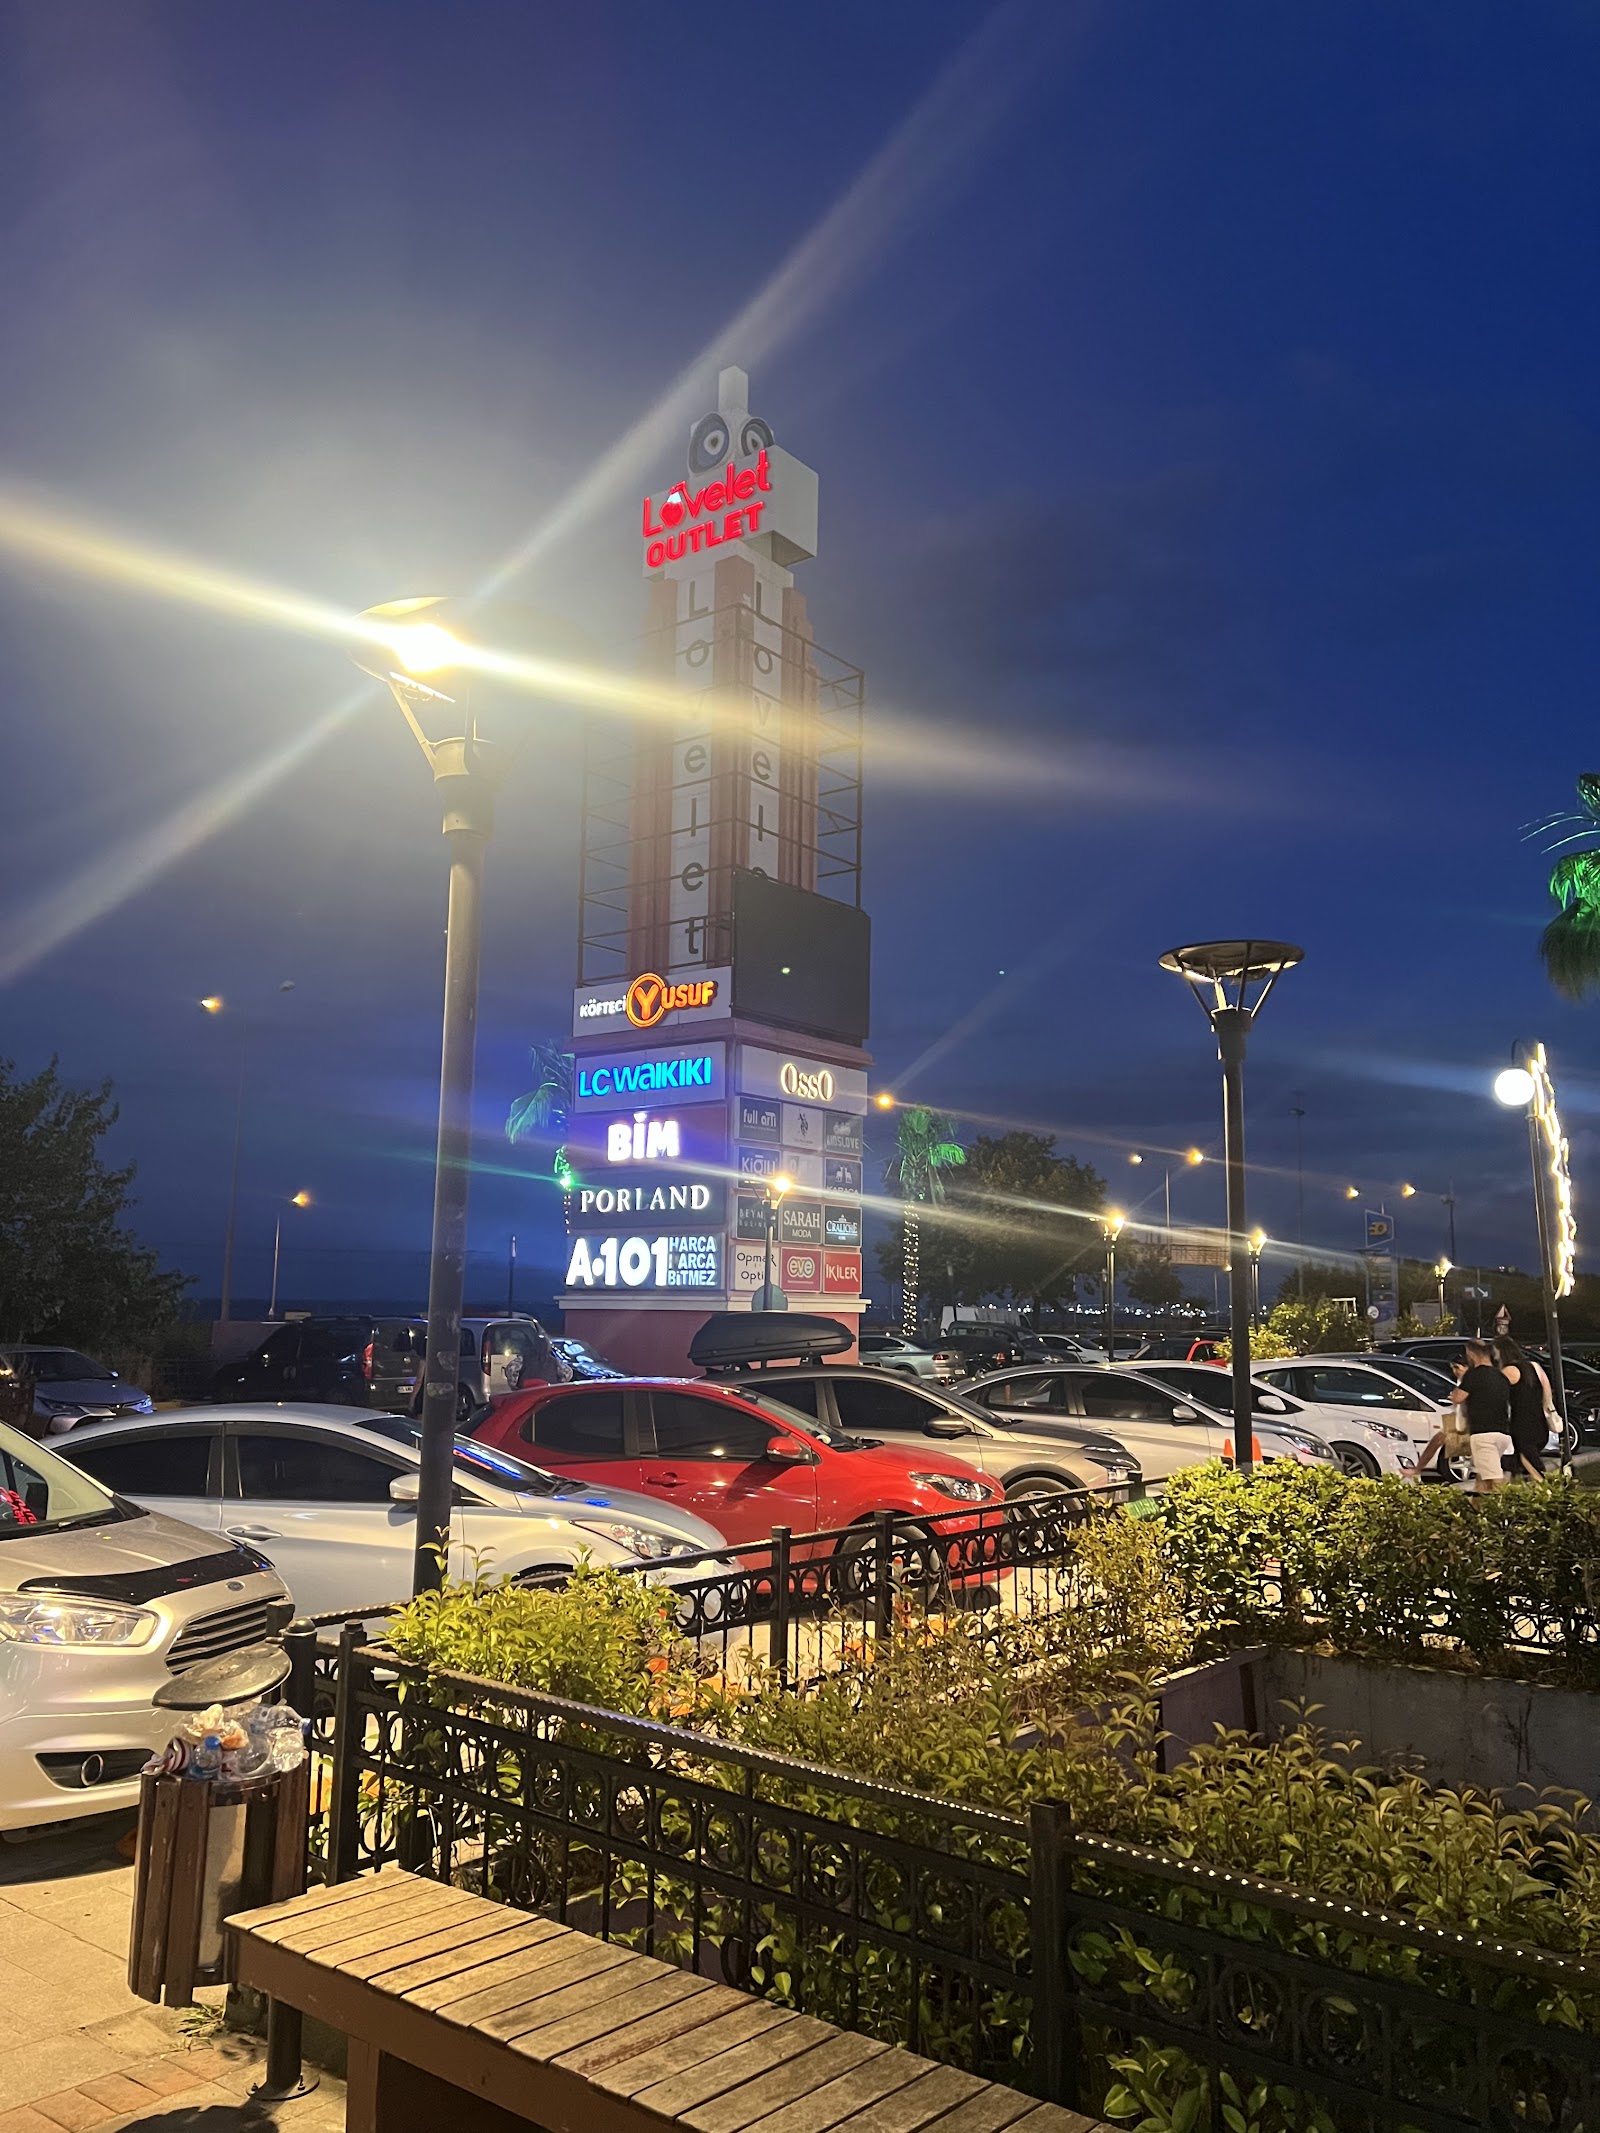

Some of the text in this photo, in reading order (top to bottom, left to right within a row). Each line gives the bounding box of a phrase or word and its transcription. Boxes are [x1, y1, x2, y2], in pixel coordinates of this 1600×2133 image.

[643, 449, 771, 537] Lovelet
[646, 501, 765, 568] OUTLET
[682, 580, 709, 955] Loelet
[632, 979, 714, 1022] YUSUF
[743, 1108, 758, 1124] full
[607, 1110, 680, 1162] BİM
[580, 1184, 710, 1213] PORLAND
[783, 1210, 821, 1229] SARAH
[668, 1235, 717, 1253] HARCA
[791, 1228, 812, 1239] MODA
[740, 1270, 764, 1285] Opti
[788, 1256, 815, 1278] eve
